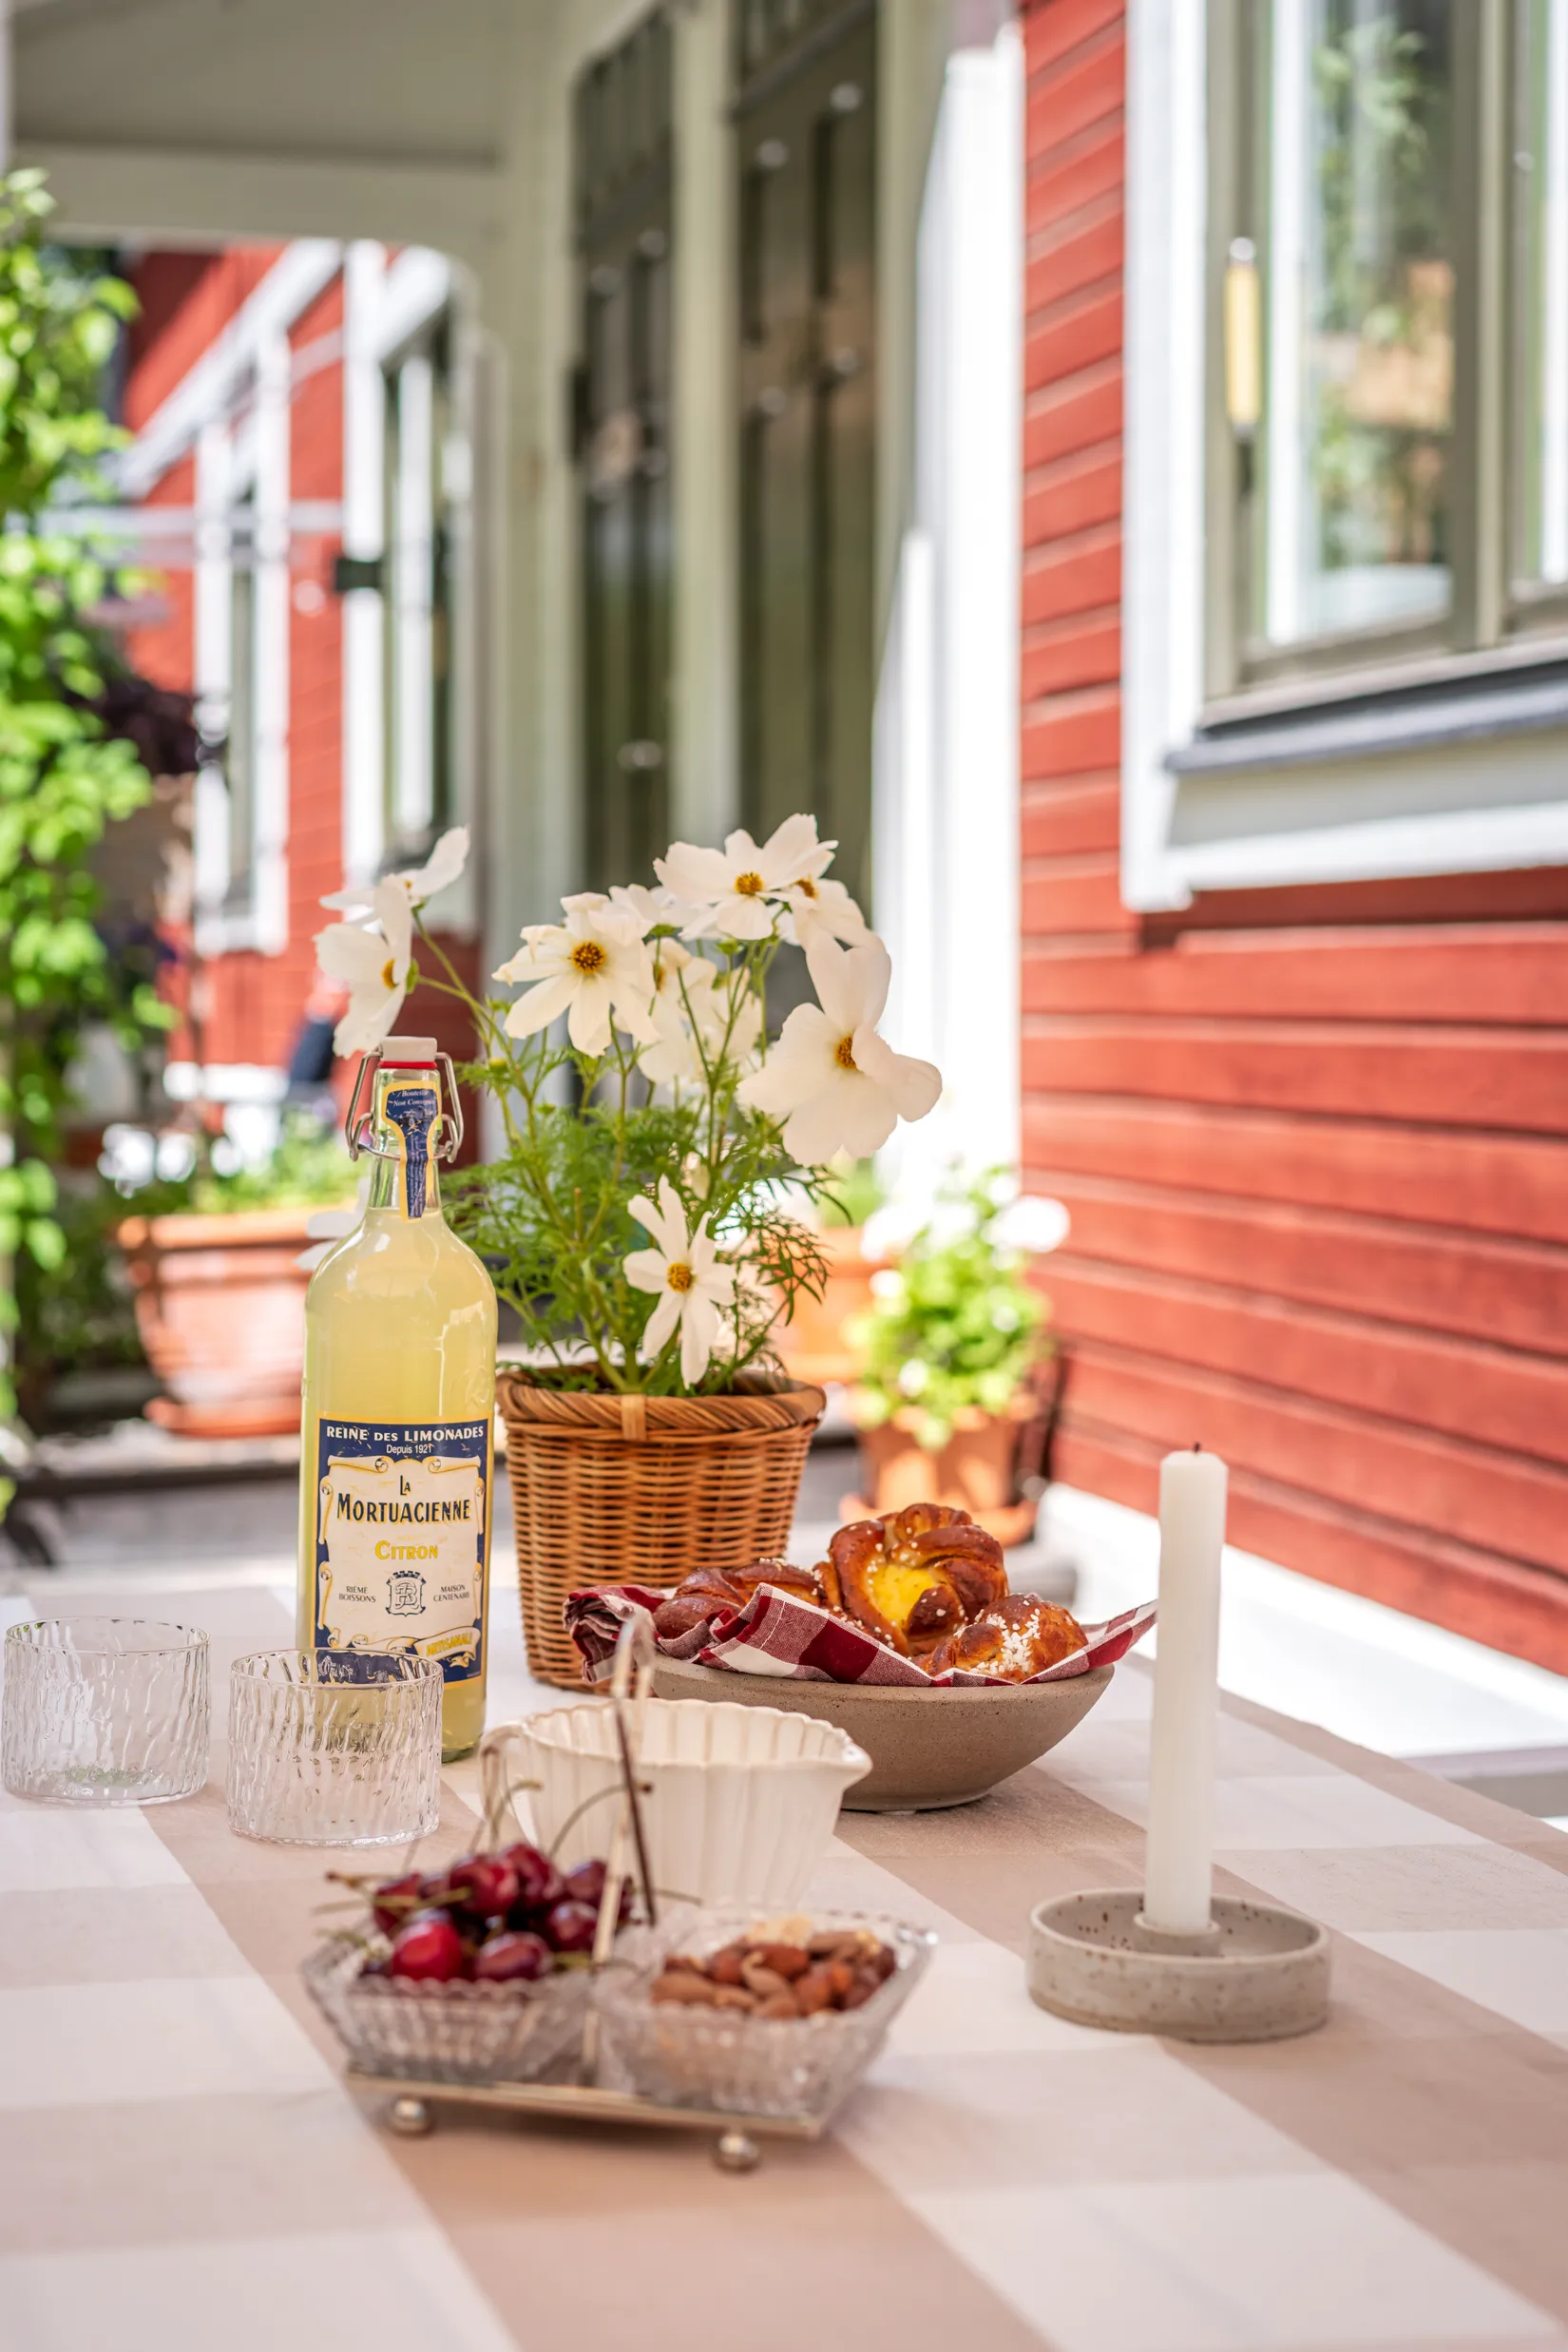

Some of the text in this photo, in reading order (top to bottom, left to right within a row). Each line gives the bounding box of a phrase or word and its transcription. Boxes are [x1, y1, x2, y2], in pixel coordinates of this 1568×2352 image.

[326, 1425, 484, 1443] REINE DES LIMONADES
[386, 1444, 431, 1456] Depuis 1921
[336, 1493, 471, 1523] MORTUACIENNE
[374, 1539, 438, 1559] CITRON
[440, 1584, 467, 1593] MAISON
[338, 1593, 377, 1603] BOISSONS
[432, 1591, 470, 1602] CENTENAIRE
